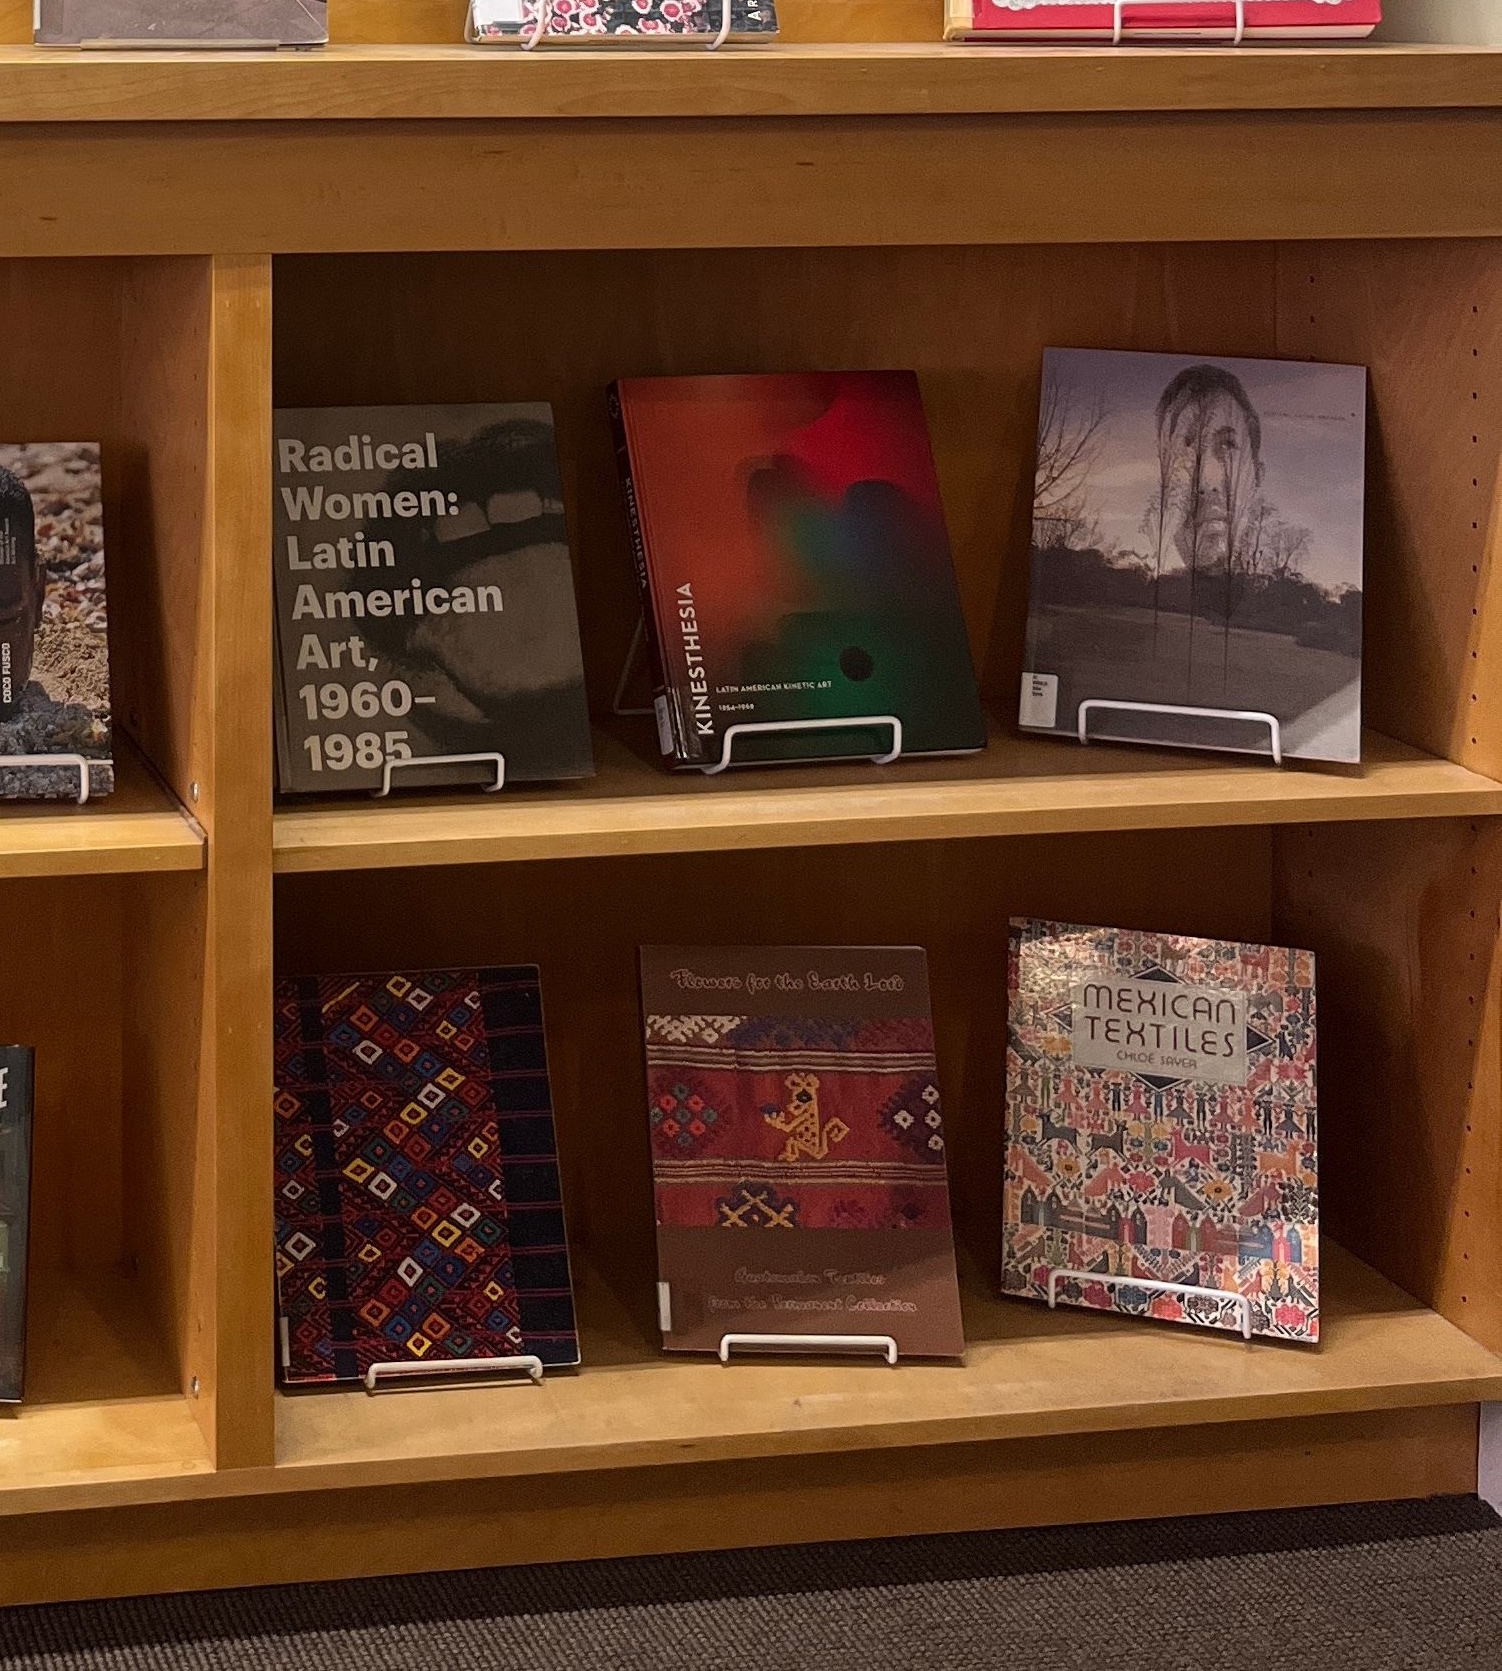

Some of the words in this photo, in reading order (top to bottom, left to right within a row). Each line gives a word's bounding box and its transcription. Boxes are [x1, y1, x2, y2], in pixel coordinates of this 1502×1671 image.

[278, 432, 439, 473] Radical
[281, 485, 459, 521] Women:
[287, 531, 395, 570] Latin
[292, 578, 503, 620] American
[2, 643, 10, 676] FUSCO
[296, 633, 379, 672] Art,
[676, 582, 714, 735] KINESTHESIA
[3, 679, 12, 703] COCO
[716, 684, 740, 693] LATIN
[742, 683, 782, 692] AMERICAN
[817, 680, 832, 689] ART
[303, 731, 412, 772] 1985
[775, 974, 804, 991] the
[1084, 983, 1236, 1025] MEXICAN
[1085, 1016, 1234, 1058] TEXTILES
